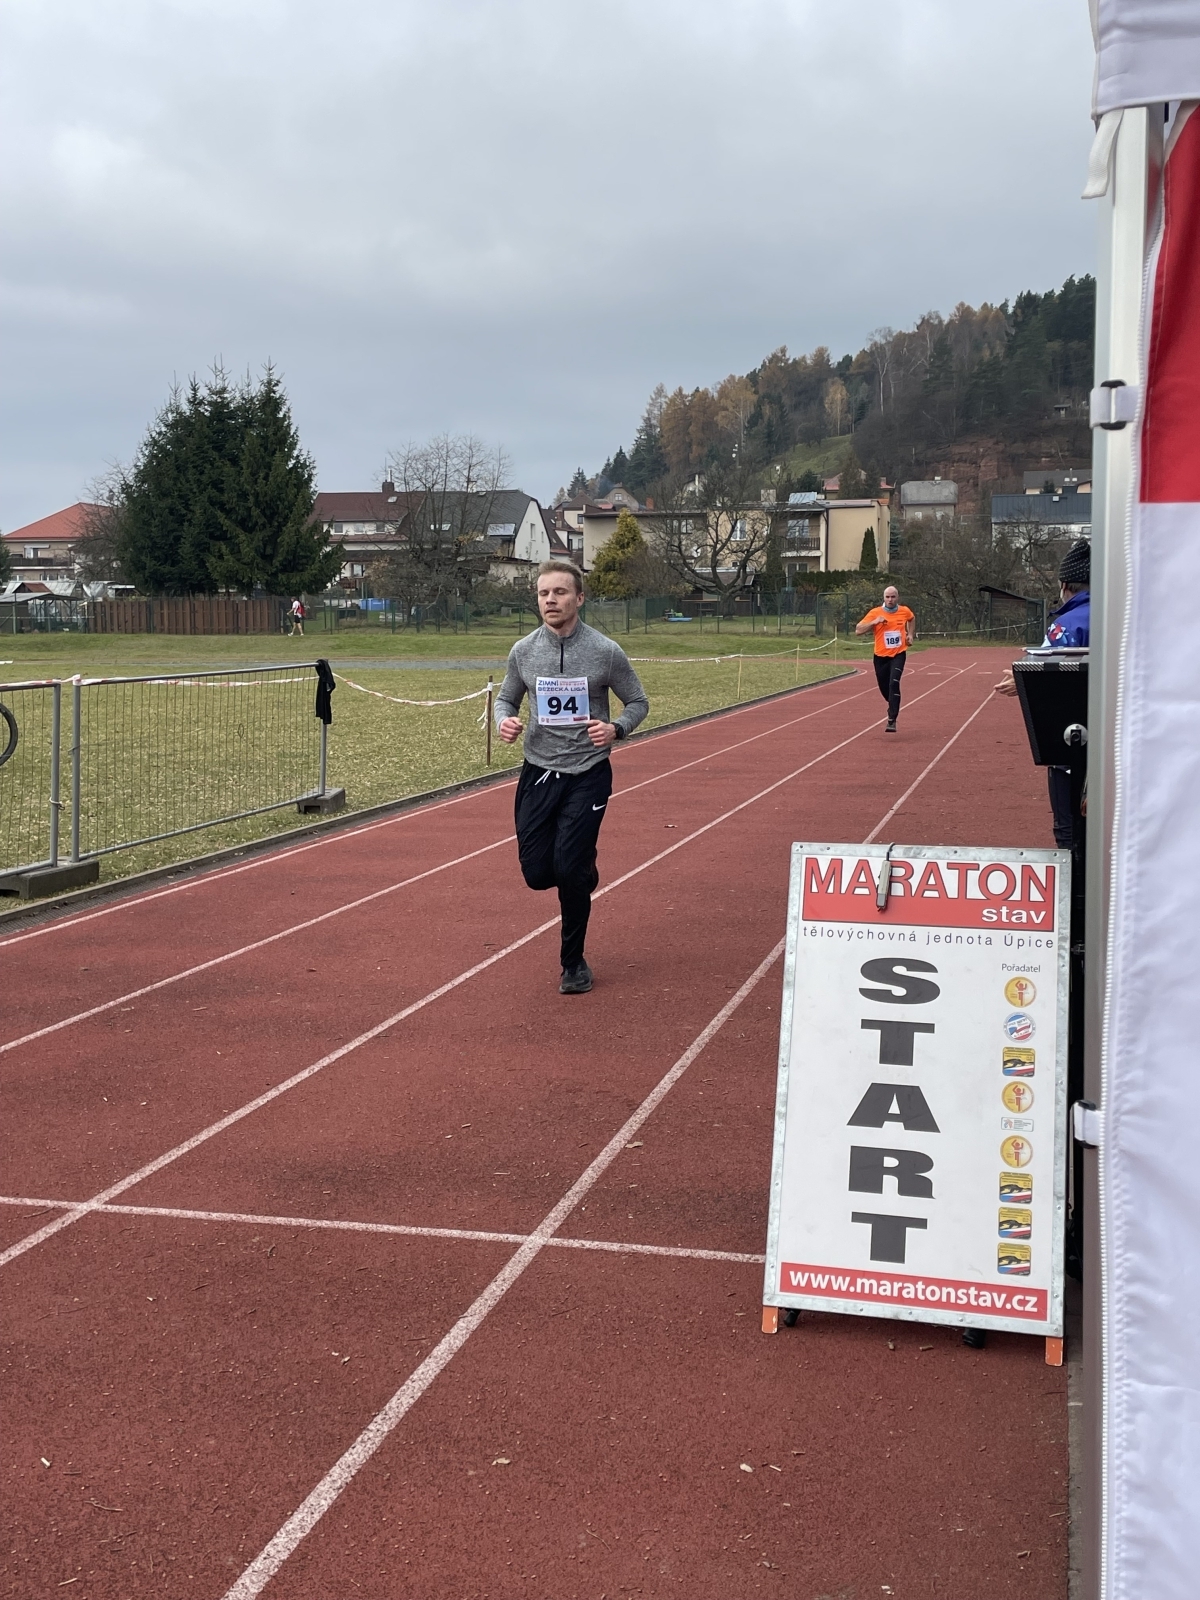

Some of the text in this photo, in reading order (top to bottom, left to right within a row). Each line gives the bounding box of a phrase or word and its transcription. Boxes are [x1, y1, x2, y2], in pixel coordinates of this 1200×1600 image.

[886, 637, 899, 645] 189
[547, 696, 579, 715] 94
[804, 857, 1056, 903] MARATON
[981, 905, 1047, 925] stav
[803, 926, 1055, 949] tělovýchovná jednota Úpice
[1001, 963, 1041, 974] Pořadatel
[846, 957, 941, 1265] START
[788, 1269, 1038, 1313] www.maratonstav.cz
